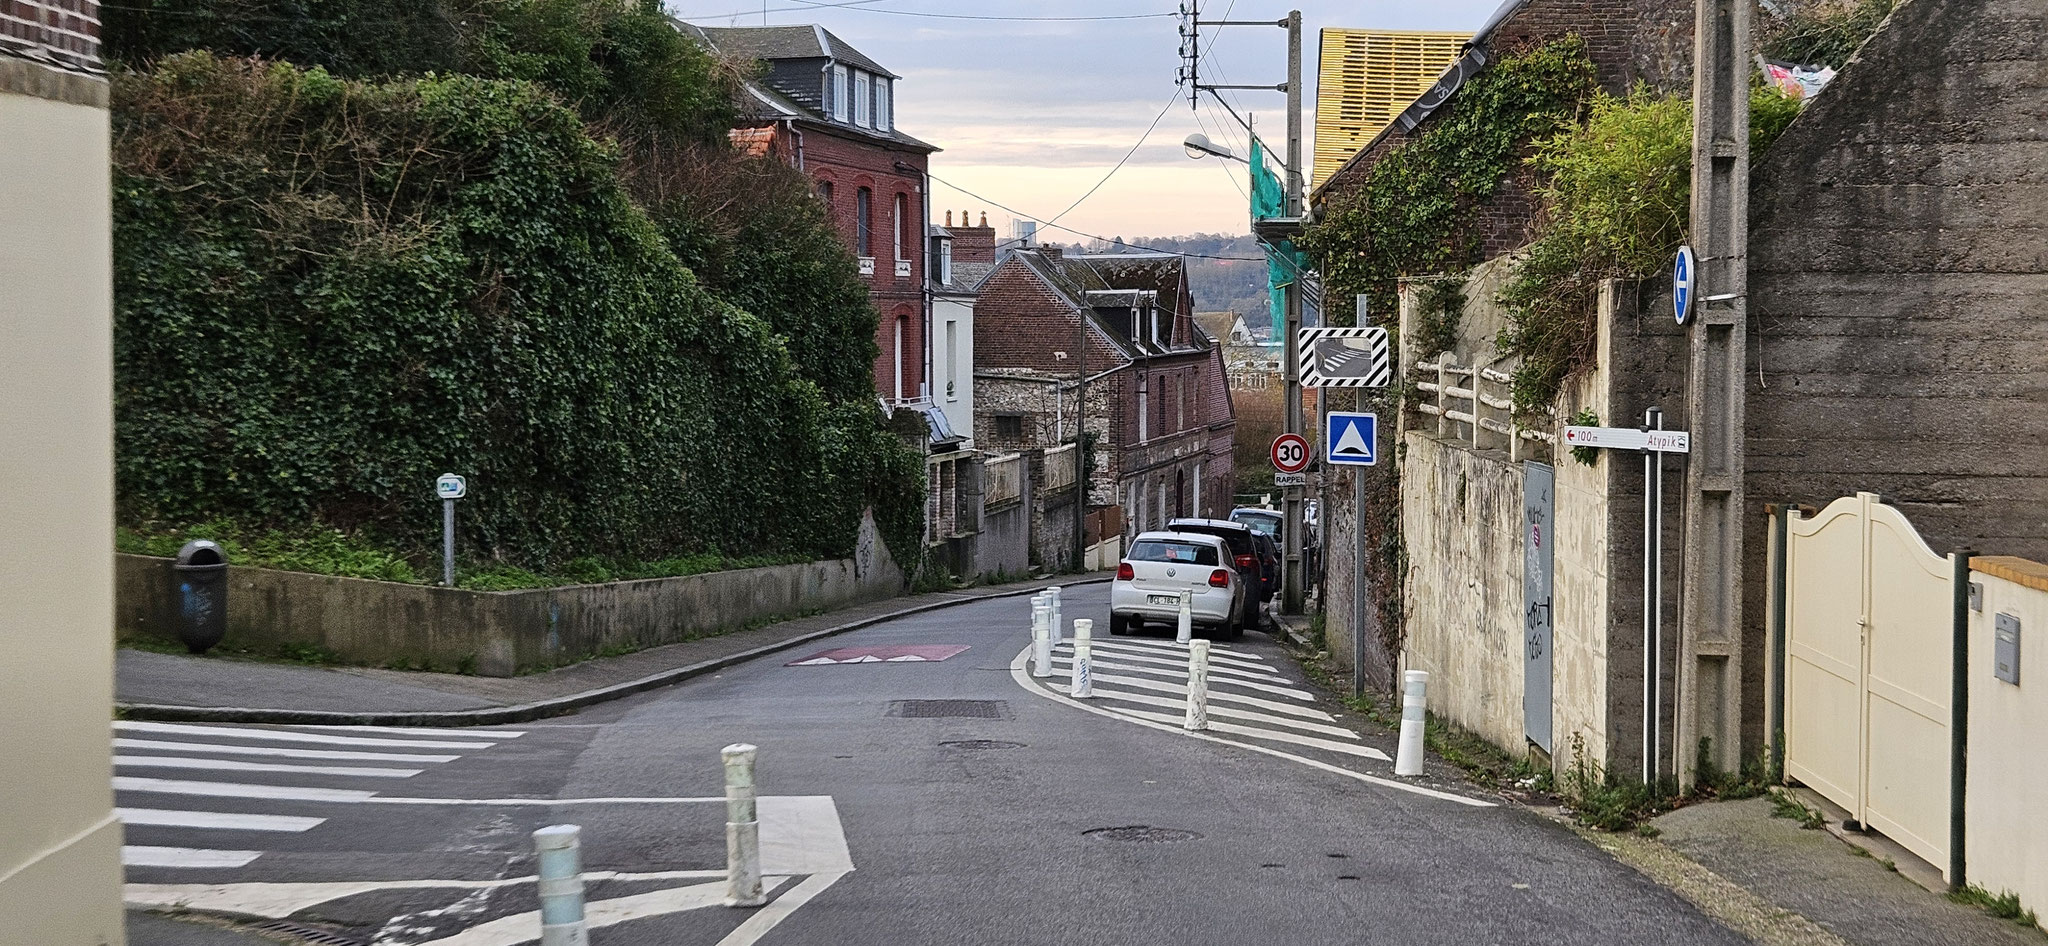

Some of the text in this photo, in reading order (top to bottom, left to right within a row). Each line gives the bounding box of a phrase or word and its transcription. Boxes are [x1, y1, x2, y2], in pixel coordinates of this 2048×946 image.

[1647, 434, 1676, 449] Atypik
[1279, 445, 1302, 461] 30
[1275, 476, 1305, 484] RAPPEL
